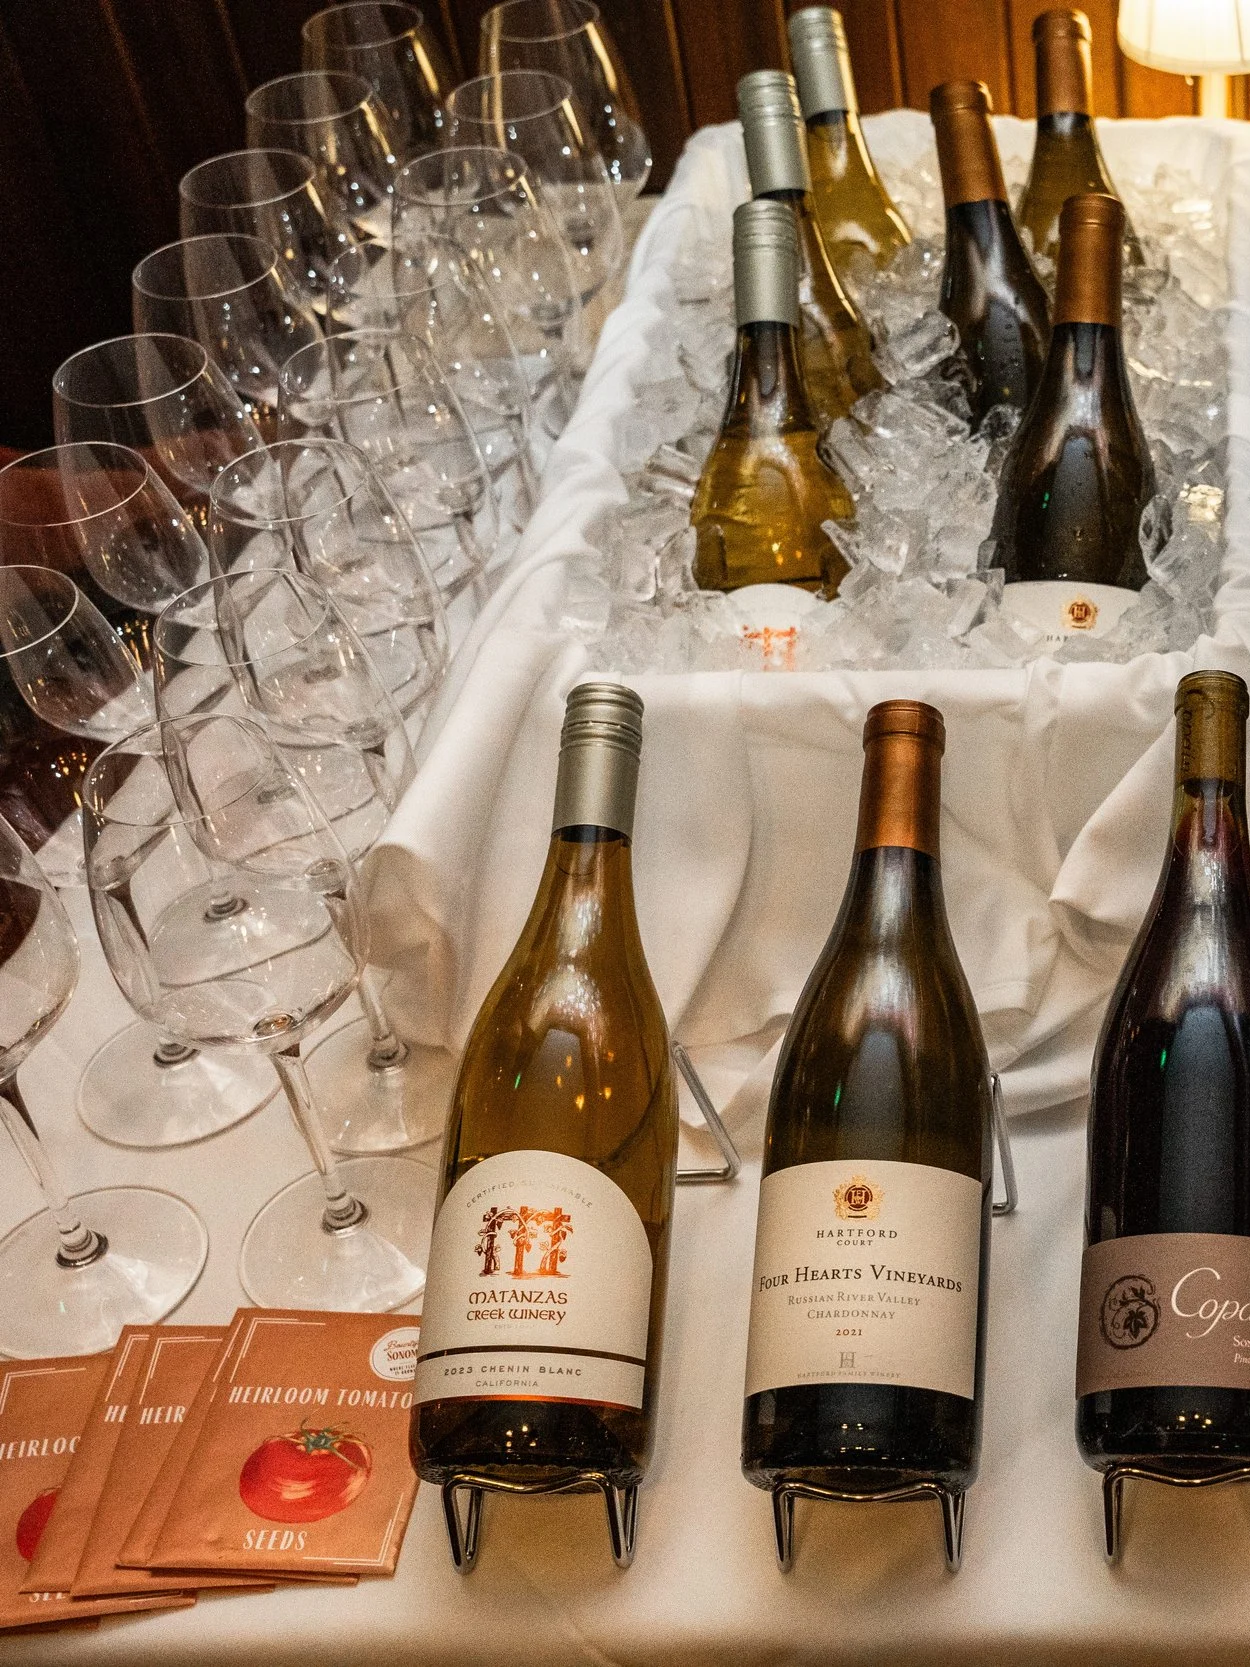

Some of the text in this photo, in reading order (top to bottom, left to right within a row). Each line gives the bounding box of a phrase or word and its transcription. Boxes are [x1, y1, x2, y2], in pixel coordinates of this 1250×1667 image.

[816, 1229, 898, 1239] HARTFORD
[759, 1264, 962, 1293] FOUR HEARTS VINEYARDS
[468, 1289, 568, 1305] MATANZAS
[788, 1291, 921, 1306] RUSSIAN RIVER VALLEY
[807, 1309, 896, 1320] CHARDONNAY
[836, 1328, 863, 1336] 2021
[444, 1365, 583, 1376] 2023 CHENIN BLANC
[475, 1379, 539, 1388] CALIFORNIA
[228, 1386, 413, 1409] HEIRLOOM TOMATO
[139, 1405, 186, 1425] HEIR
[242, 1528, 308, 1552] SEEDS
